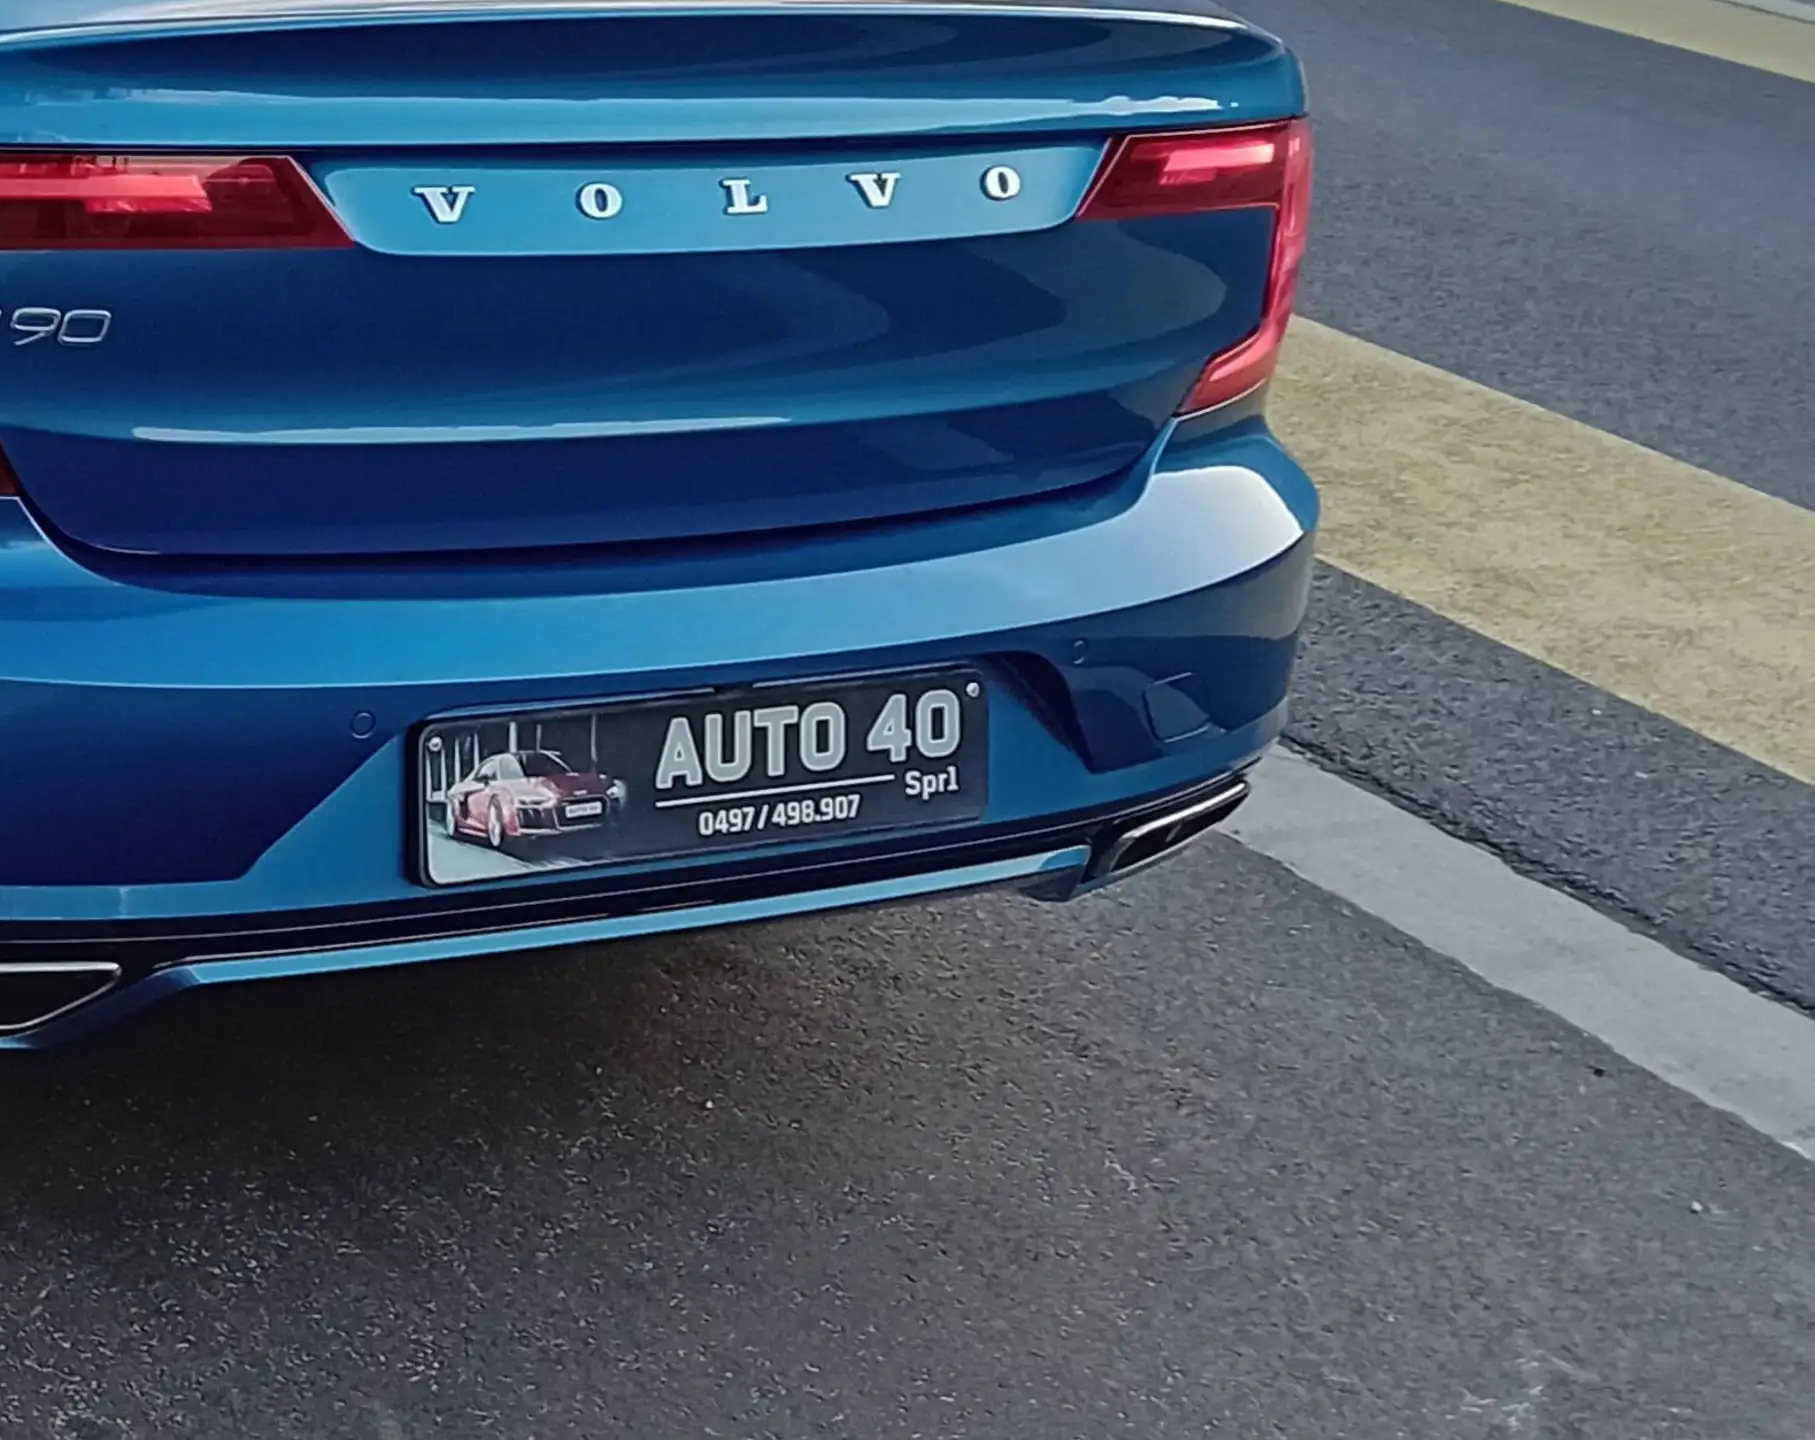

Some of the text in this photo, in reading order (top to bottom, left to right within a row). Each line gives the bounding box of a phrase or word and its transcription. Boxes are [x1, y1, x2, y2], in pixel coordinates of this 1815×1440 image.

[413, 165, 1021, 223] VOLVO
[656, 689, 961, 789] AUTO 40
